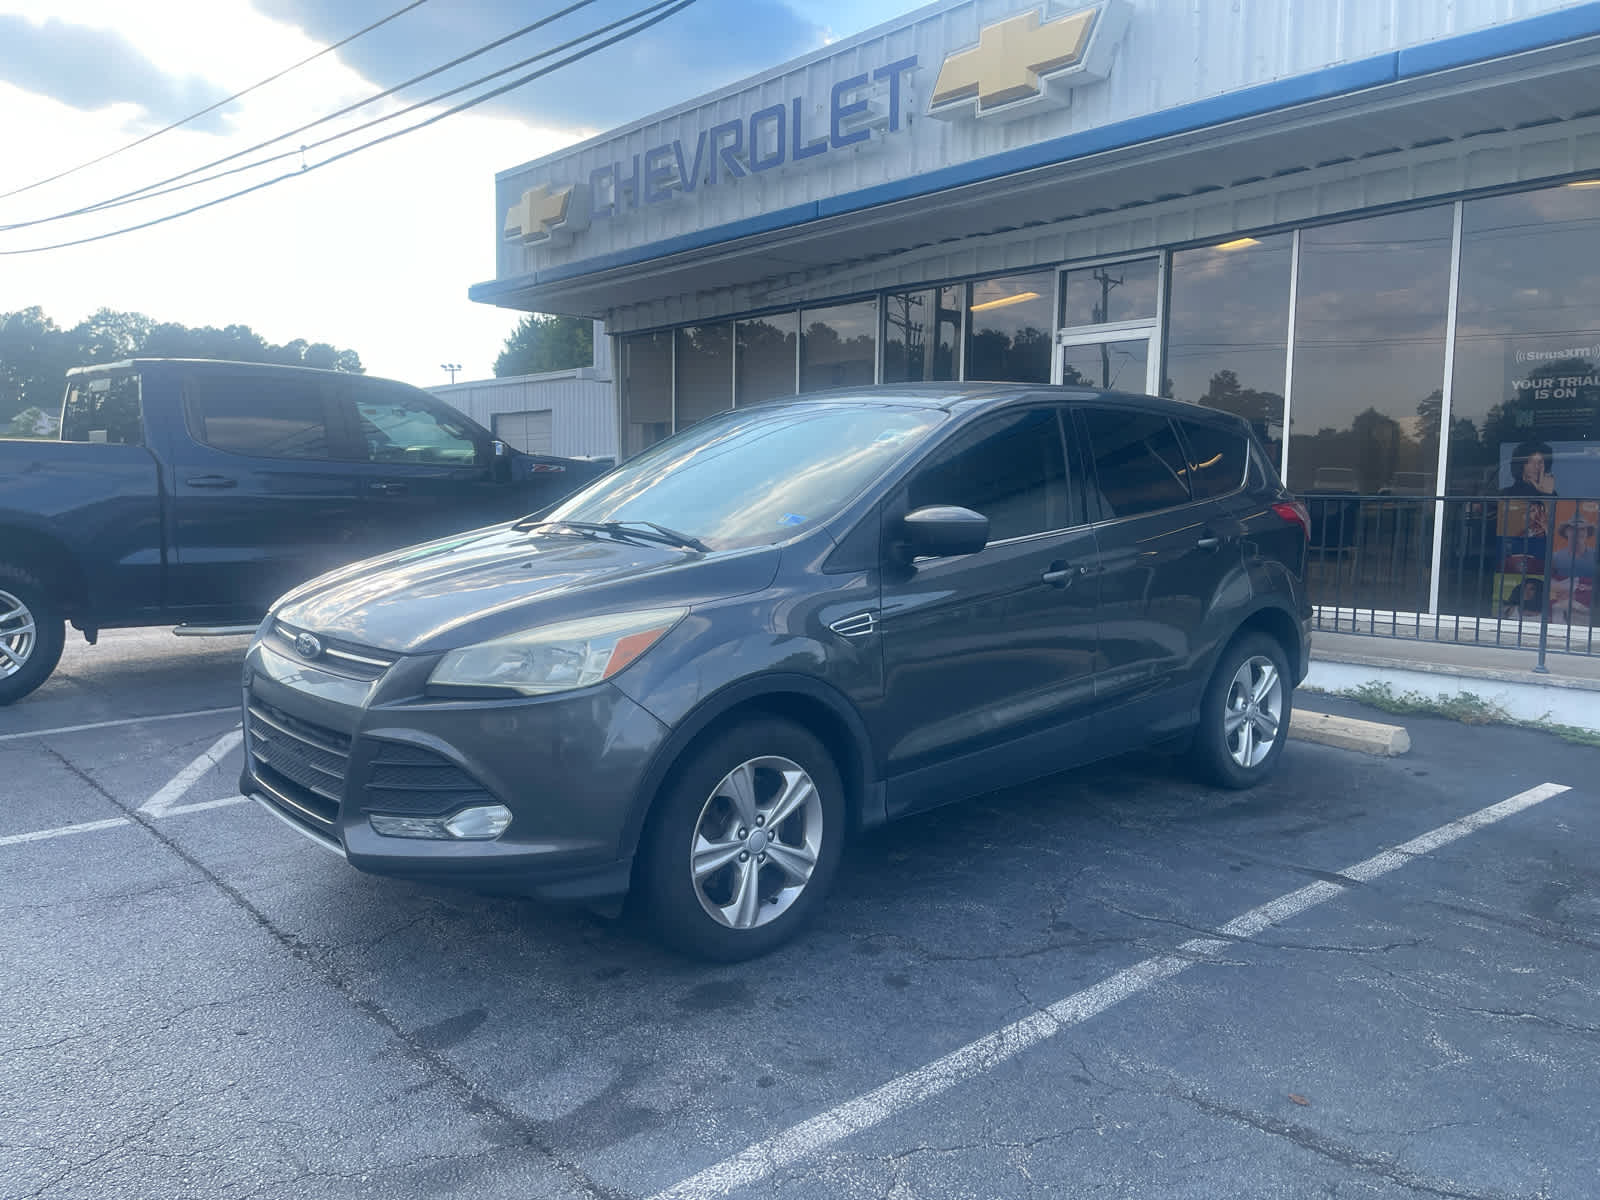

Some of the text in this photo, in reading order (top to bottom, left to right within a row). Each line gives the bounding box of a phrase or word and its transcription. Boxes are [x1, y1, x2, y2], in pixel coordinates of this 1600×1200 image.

[589, 55, 918, 218] CHEVROLET
[1512, 379, 1553, 390] YOUR
[1535, 388, 1576, 400] IS ON
